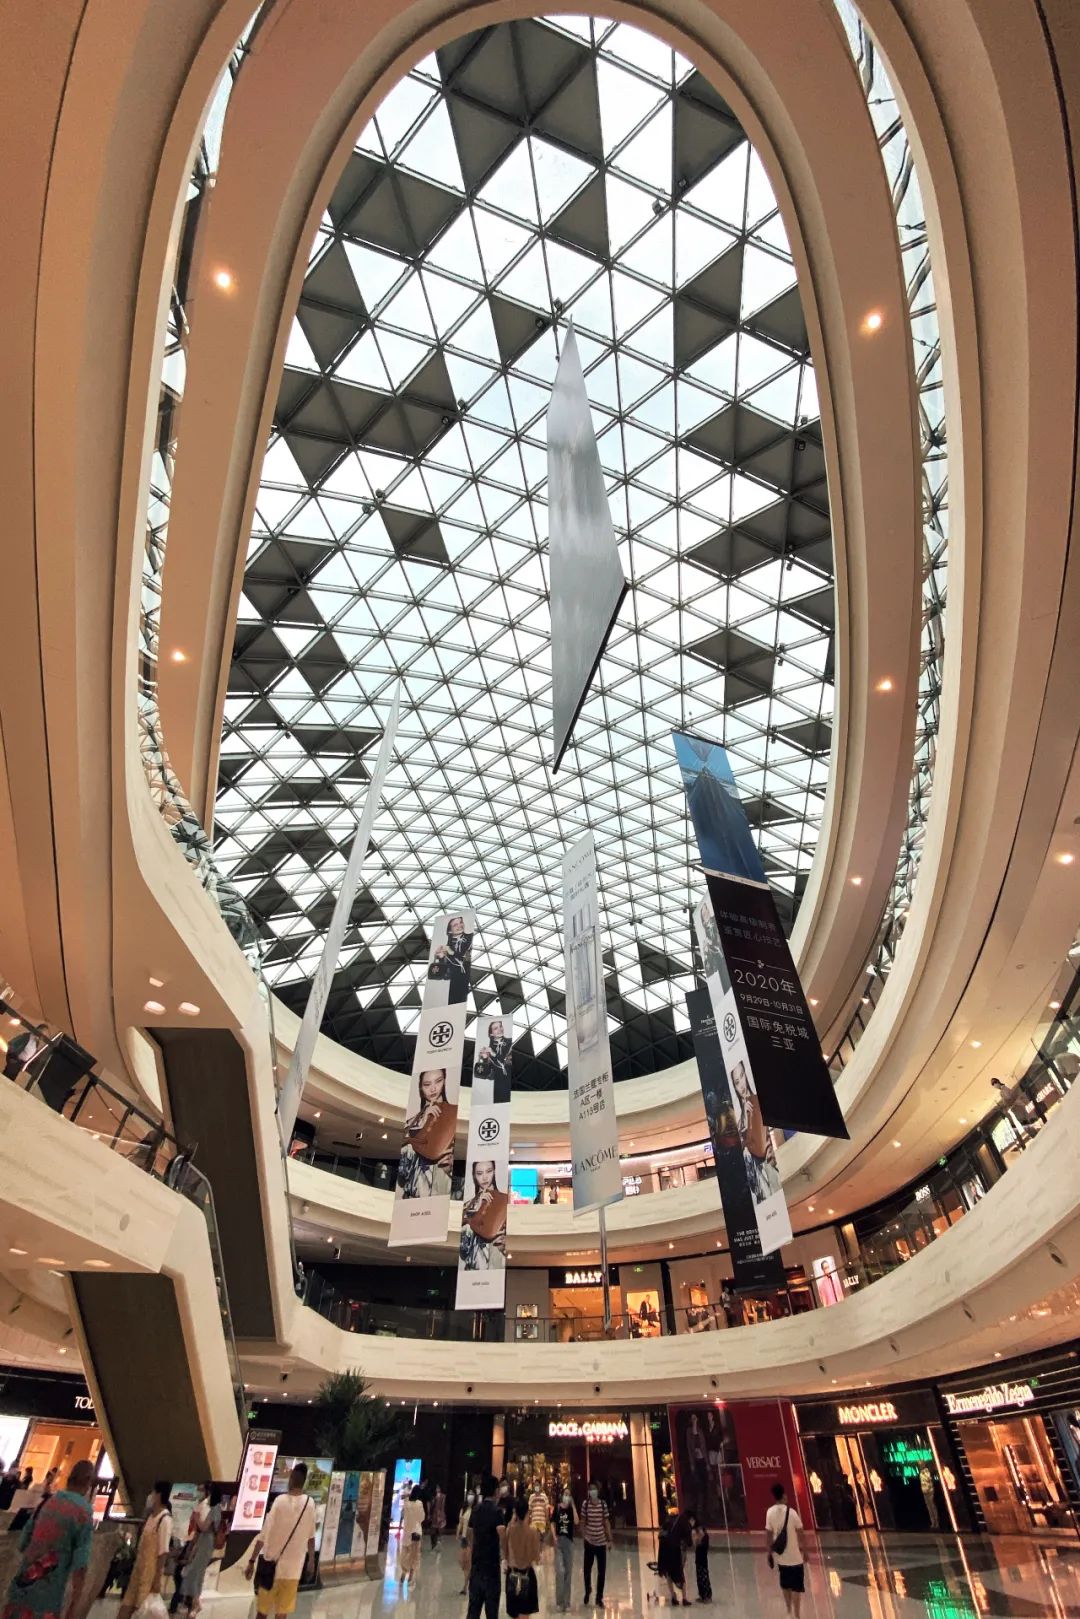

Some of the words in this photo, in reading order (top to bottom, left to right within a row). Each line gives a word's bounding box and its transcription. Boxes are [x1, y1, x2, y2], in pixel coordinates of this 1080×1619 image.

[734, 969, 797, 996] 2020年
[740, 993, 803, 1015] 9月29日-10月31日
[746, 1015, 810, 1040] 国际免税城
[770, 1035, 796, 1051] 三亚
[580, 1088, 602, 1106] A区一楼
[565, 1271, 602, 1284] BALLY
[838, 1402, 898, 1424] MONCLER
[745, 1455, 782, 1469] VERSACE
